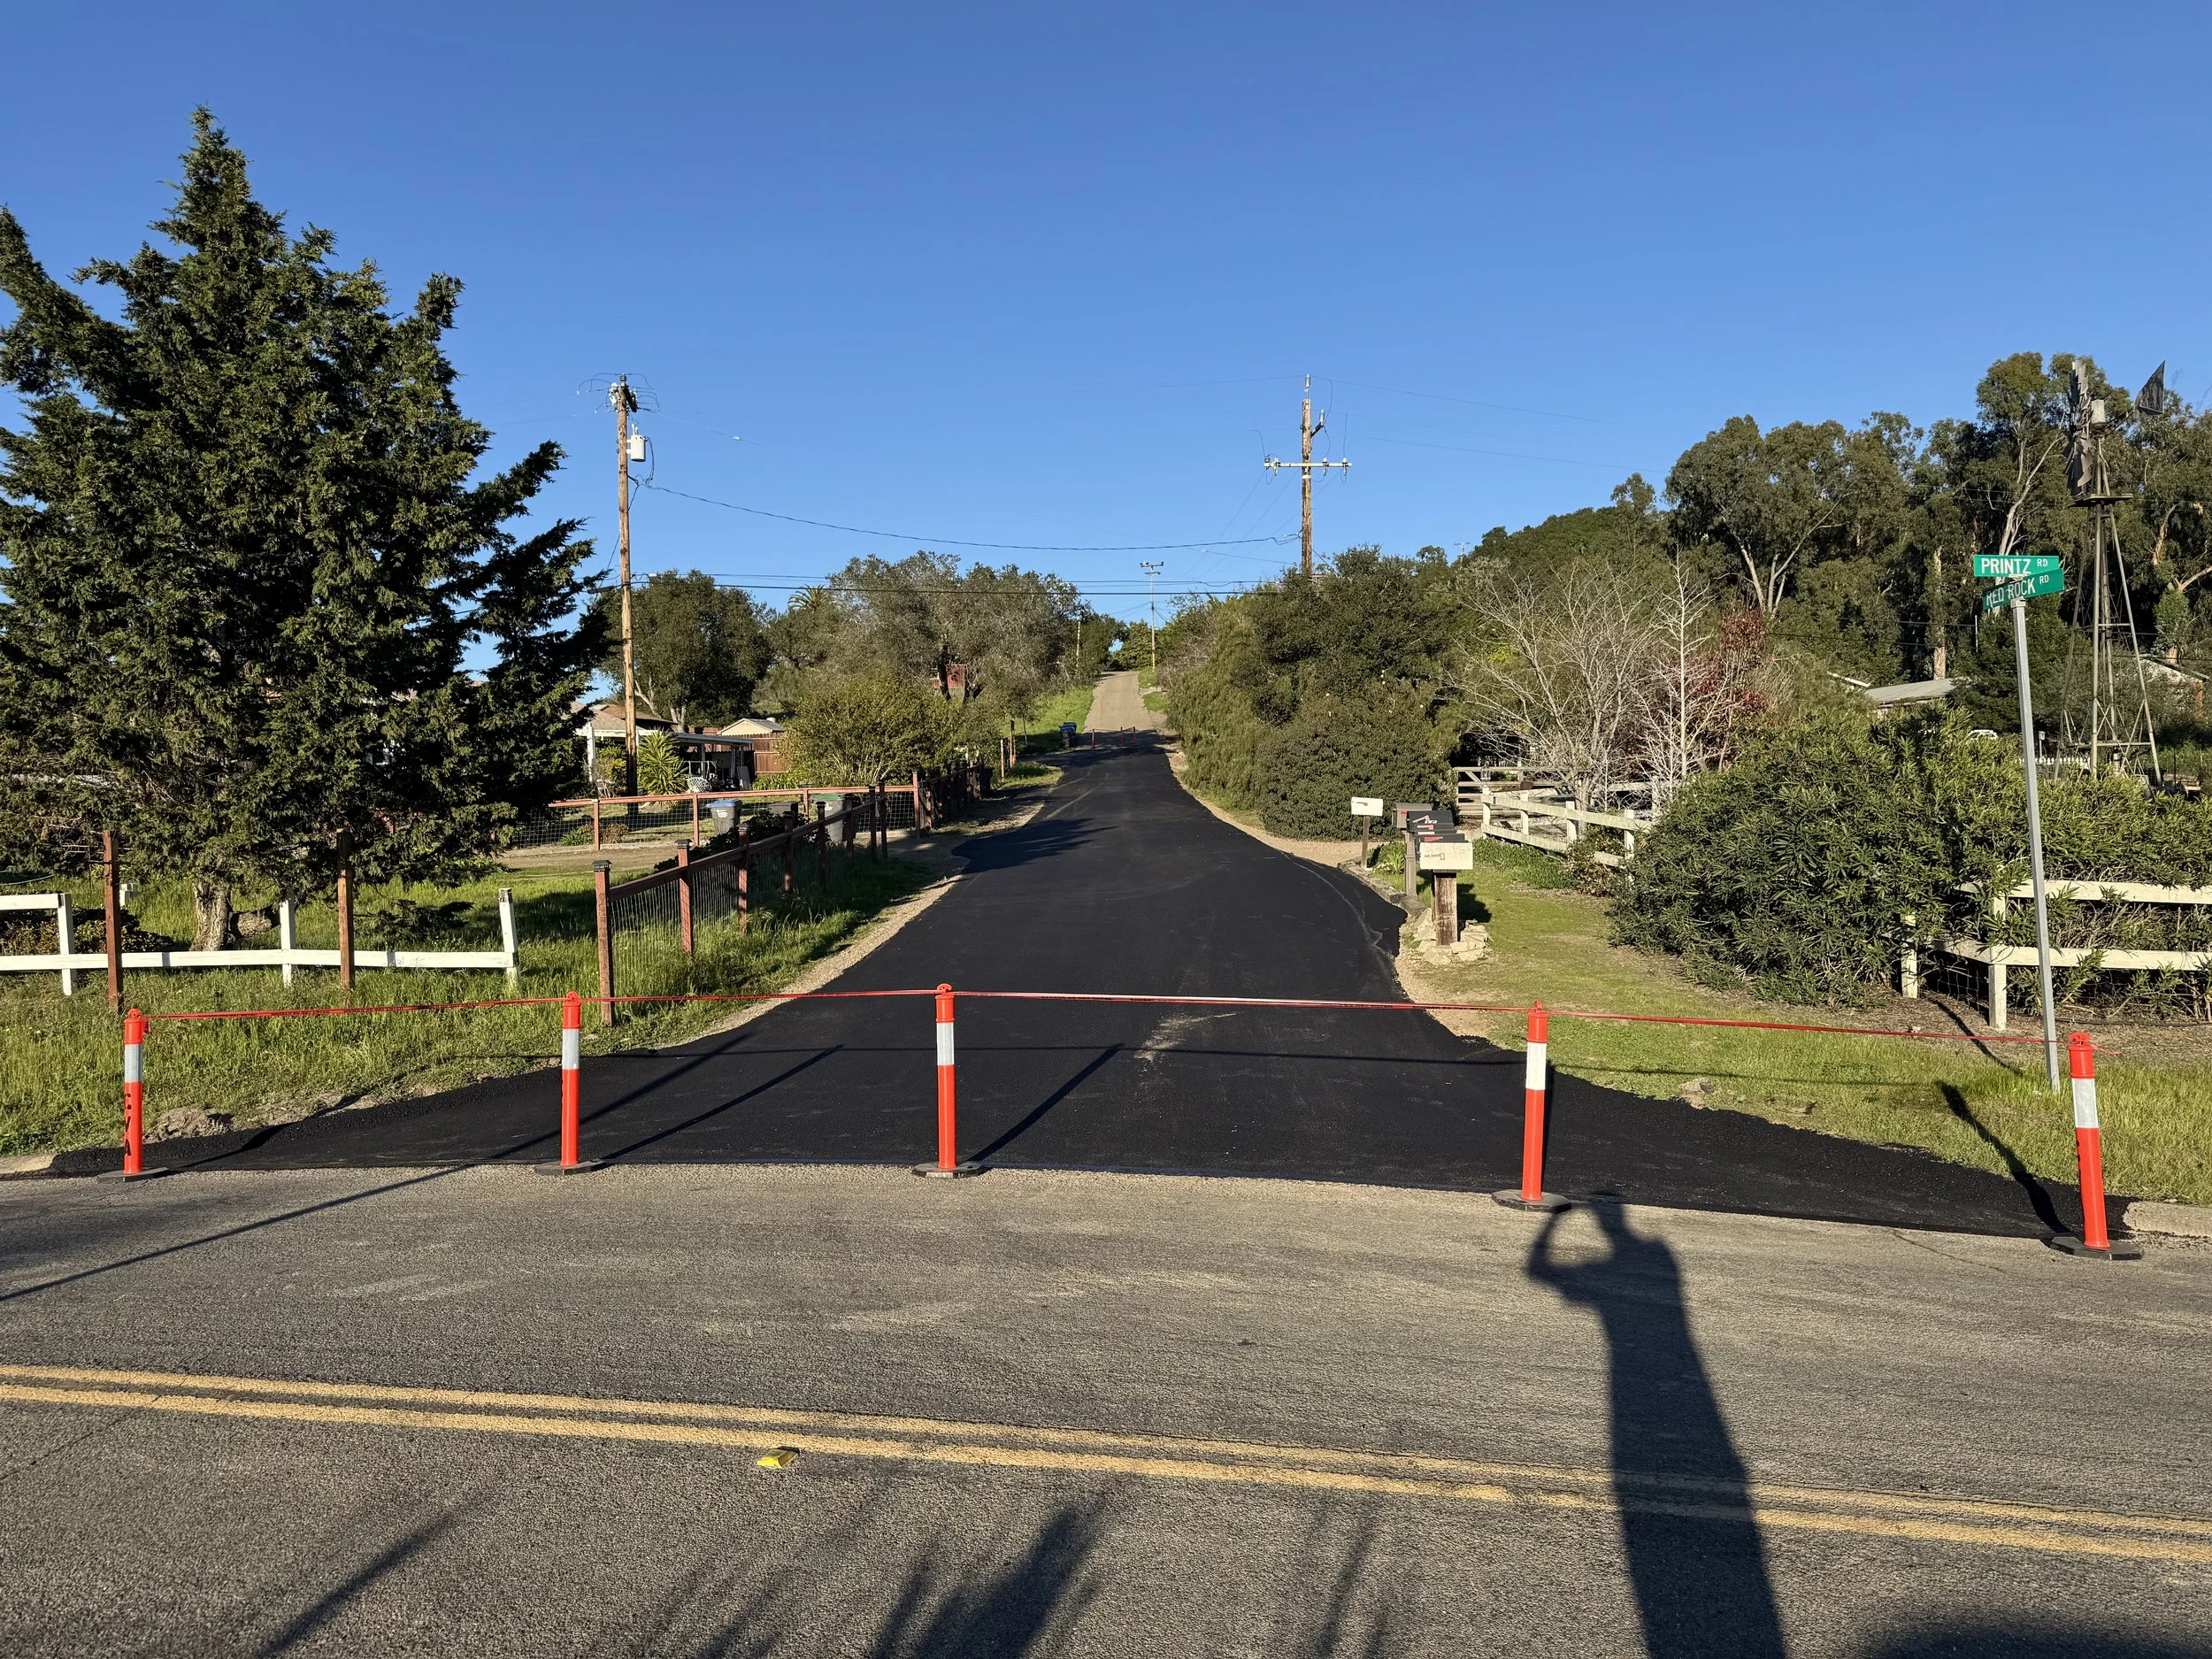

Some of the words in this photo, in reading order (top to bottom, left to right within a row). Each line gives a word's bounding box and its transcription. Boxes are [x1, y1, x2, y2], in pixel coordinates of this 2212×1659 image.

[1981, 558, 2032, 574] PRINTZ
[2037, 558, 2047, 567] RD
[1986, 588, 2004, 609] RED
[2008, 578, 2036, 598] ROCK
[2039, 575, 2049, 585] RD
